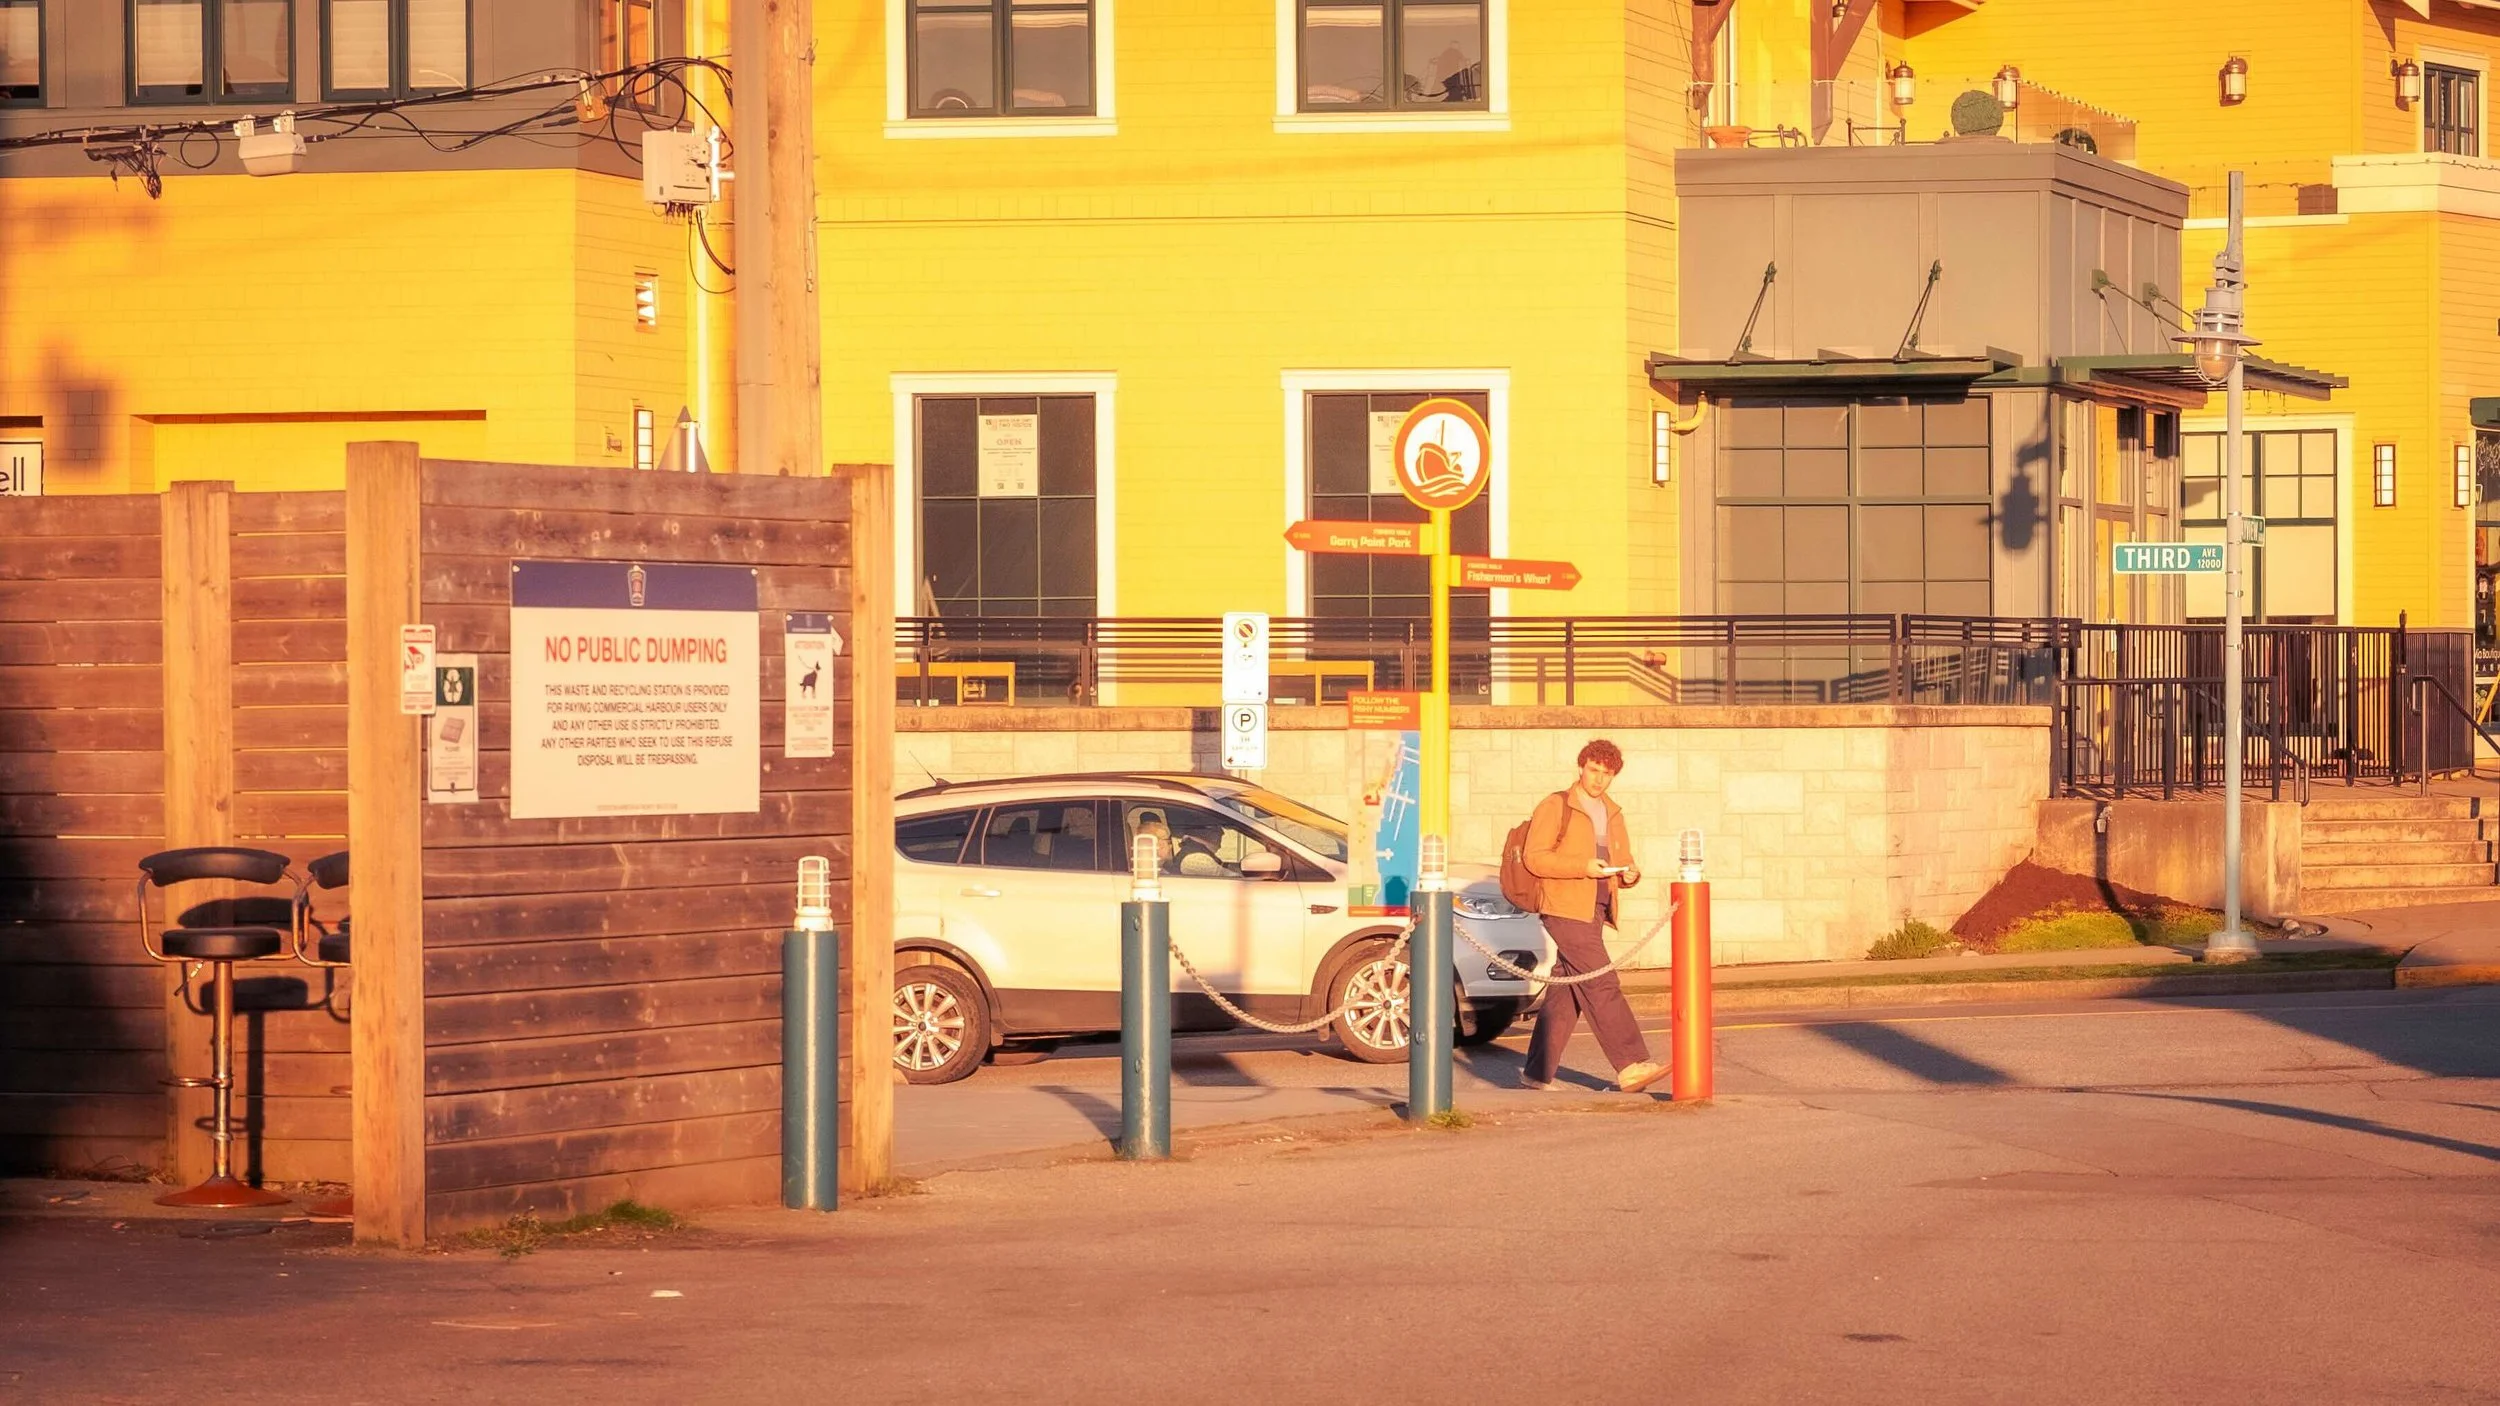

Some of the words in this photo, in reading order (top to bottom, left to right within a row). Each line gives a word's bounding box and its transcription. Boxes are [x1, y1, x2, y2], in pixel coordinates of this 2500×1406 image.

[1360, 536, 1385, 547] Point
[1388, 537, 1411, 548] Park
[2124, 548, 2190, 569] THIRD
[2202, 548, 2216, 558] AVE
[2197, 559, 2221, 568] 12000
[1467, 570, 1521, 583] Fisherman's
[1523, 573, 1552, 584] Wharf
[545, 636, 571, 662] NO
[578, 636, 640, 662] PUBLIC
[647, 638, 727, 663] DUMPING
[545, 685, 562, 696] THIS
[564, 685, 589, 696] WASTE
[592, 685, 609, 696] AND
[610, 685, 651, 696] RECYCLING
[654, 685, 683, 696] STATION
[685, 685, 691, 696] IS
[693, 685, 729, 696] PROVIDED
[1352, 696, 1384, 705] FOLLOW
[1386, 697, 1400, 705] THE
[547, 702, 562, 713] FOR
[564, 702, 591, 713] PAYING
[593, 702, 643, 713] COMMERCIAL
[646, 702, 682, 713] HARBOUR
[684, 702, 708, 713] USERS
[709, 702, 727, 713] ONLY
[552, 720, 568, 731] AND
[570, 720, 585, 731] ANY
[587, 720, 612, 730] OTHER
[615, 720, 629, 730] USE
[631, 719, 637, 730] IS
[640, 719, 673, 730] STRICTLY
[676, 719, 720, 730] PROHIBITED.
[1240, 713, 1251, 727] P
[541, 737, 557, 748] ANY
[559, 737, 584, 748] OTHER
[587, 737, 616, 748] PARTIES
[619, 737, 636, 747] WHO
[638, 737, 657, 747] SEEK
[659, 736, 669, 747] TO
[671, 736, 685, 747] USE
[687, 736, 703, 747] THIS
[705, 736, 732, 747] REFUSE
